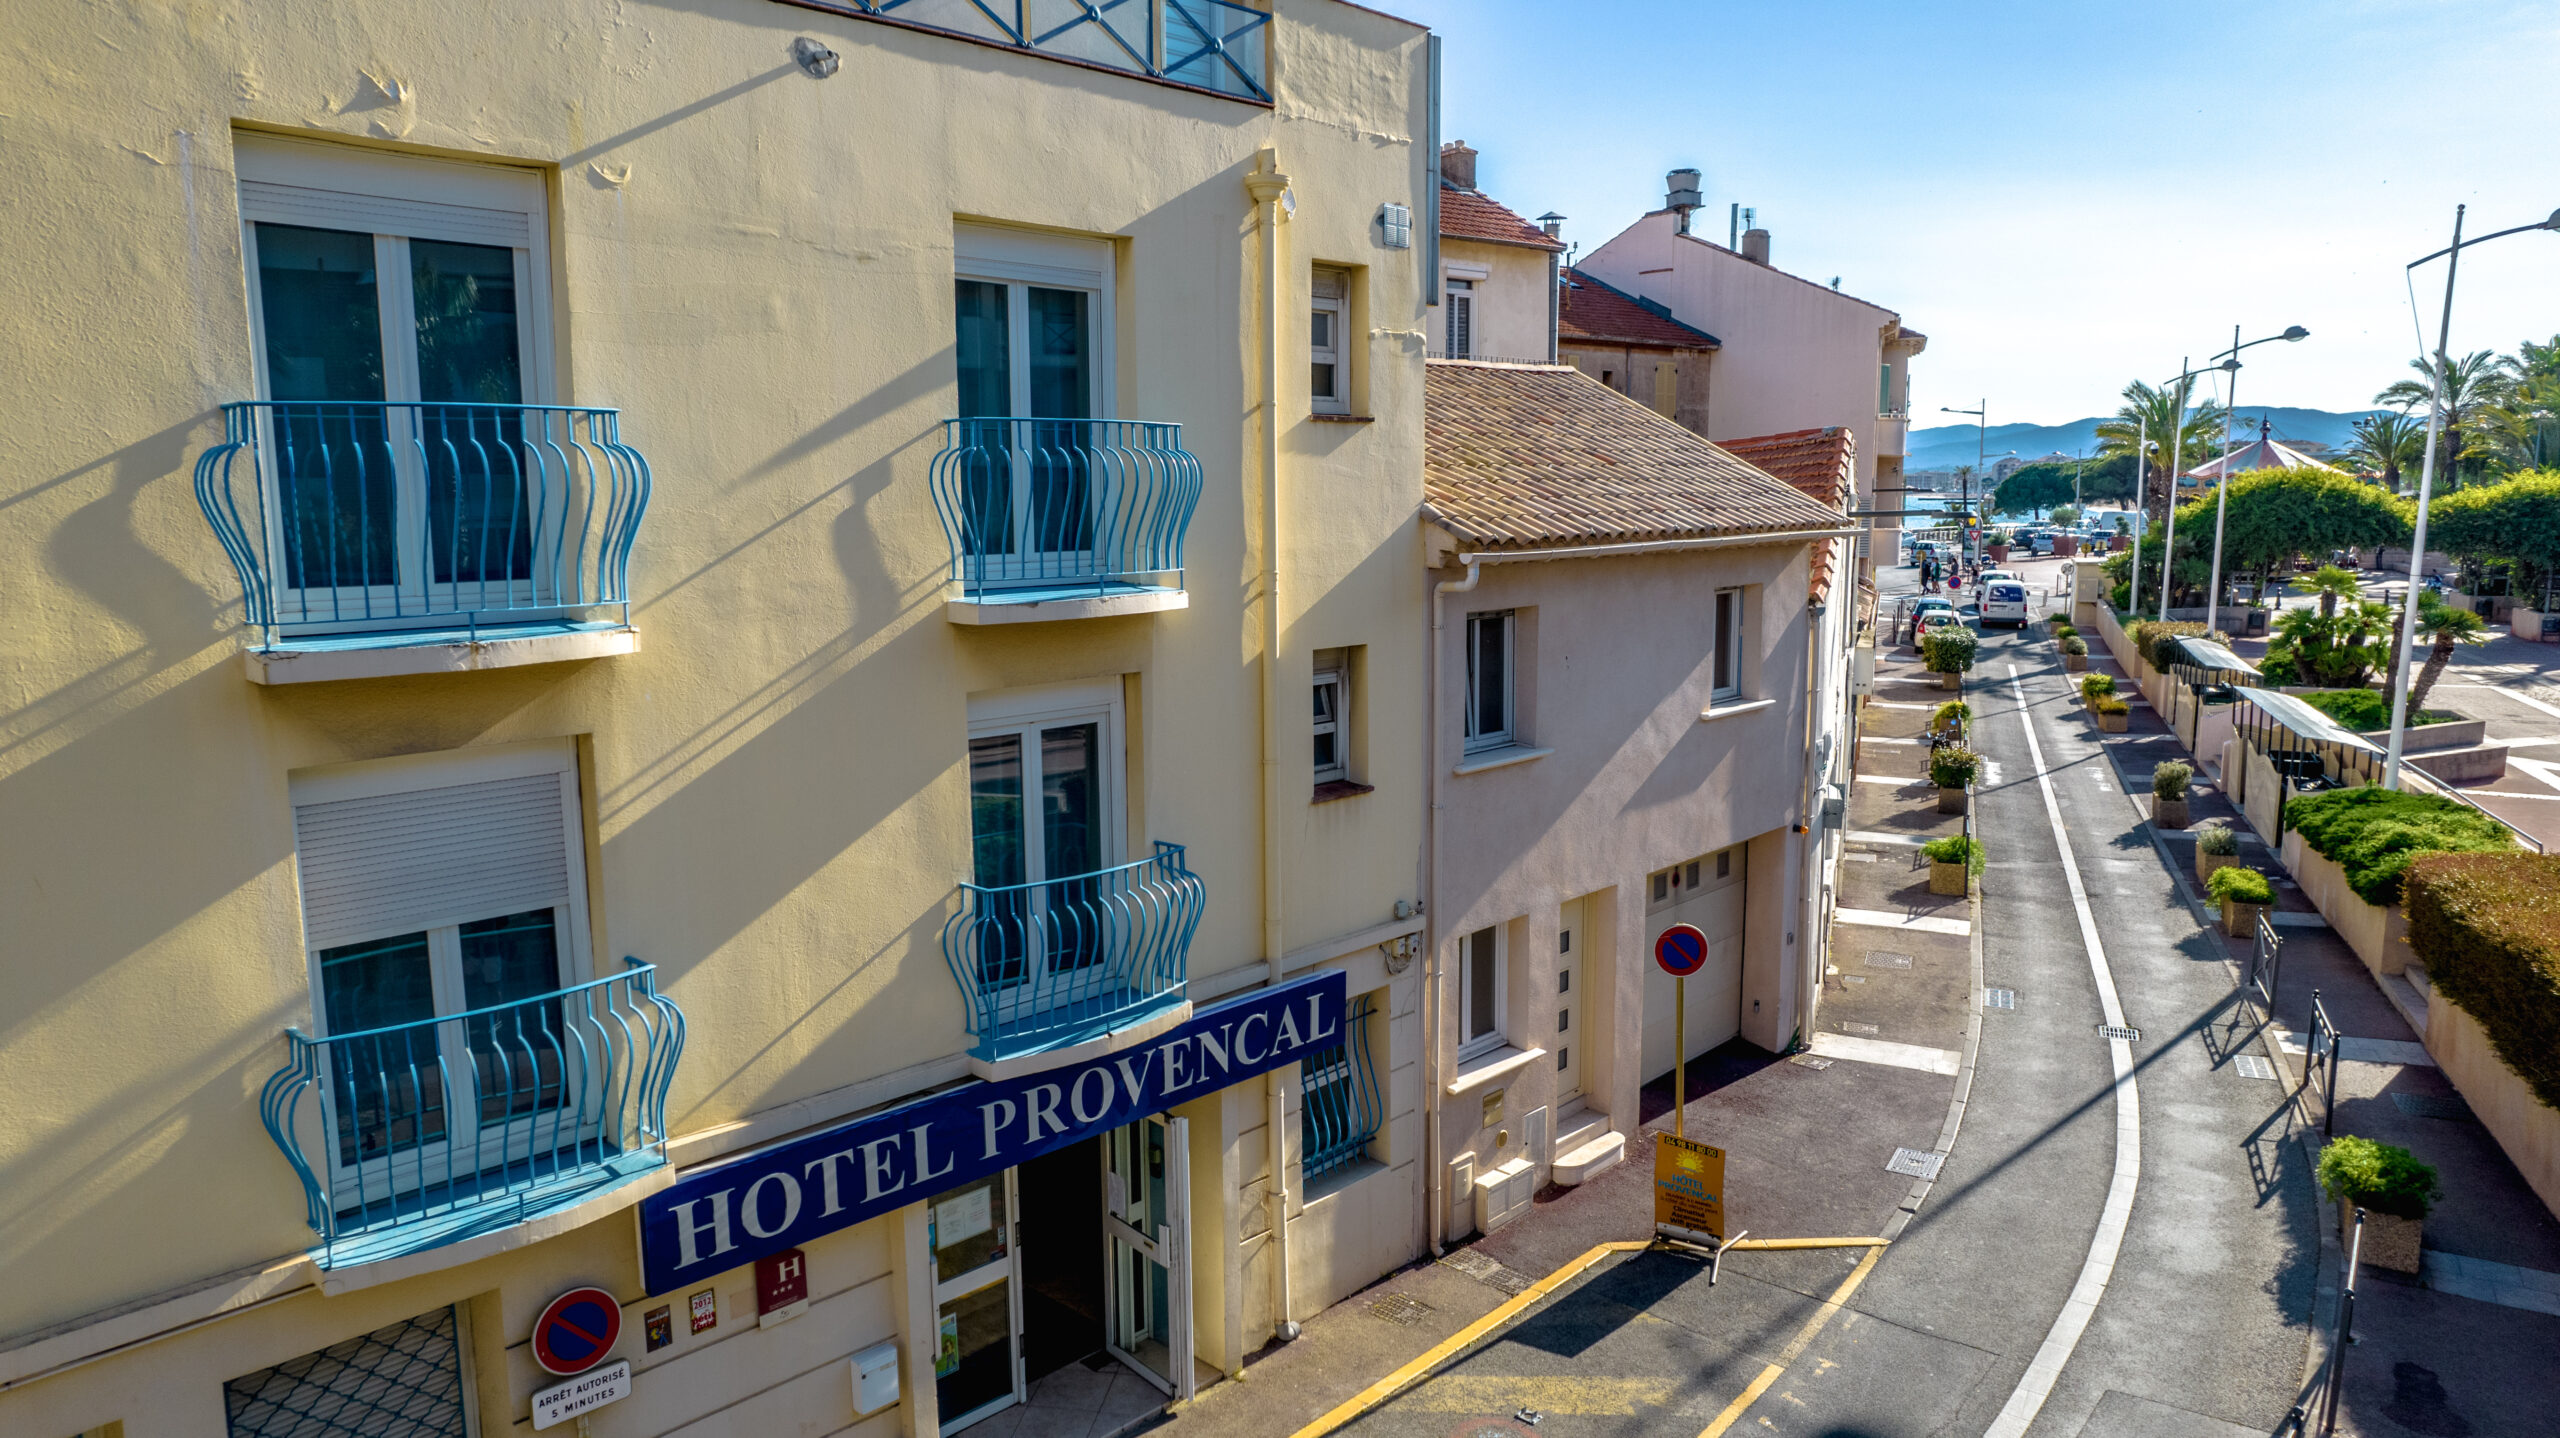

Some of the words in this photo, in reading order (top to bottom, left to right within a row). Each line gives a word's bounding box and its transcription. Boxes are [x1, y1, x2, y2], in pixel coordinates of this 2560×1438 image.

[668, 1121, 955, 1271] HOTEL
[977, 991, 1336, 1159] PROVENCAL
[1657, 1179, 1719, 1203] PROVENÇAL
[1672, 1174, 1703, 1190] HÔTEL
[777, 1256, 801, 1284] H
[693, 1297, 712, 1310] 2012
[539, 1388, 572, 1408] ARRÊT
[576, 1367, 625, 1394] AUTORISÉ
[552, 1409, 559, 1418] 5
[565, 1387, 615, 1413] MINUTES
